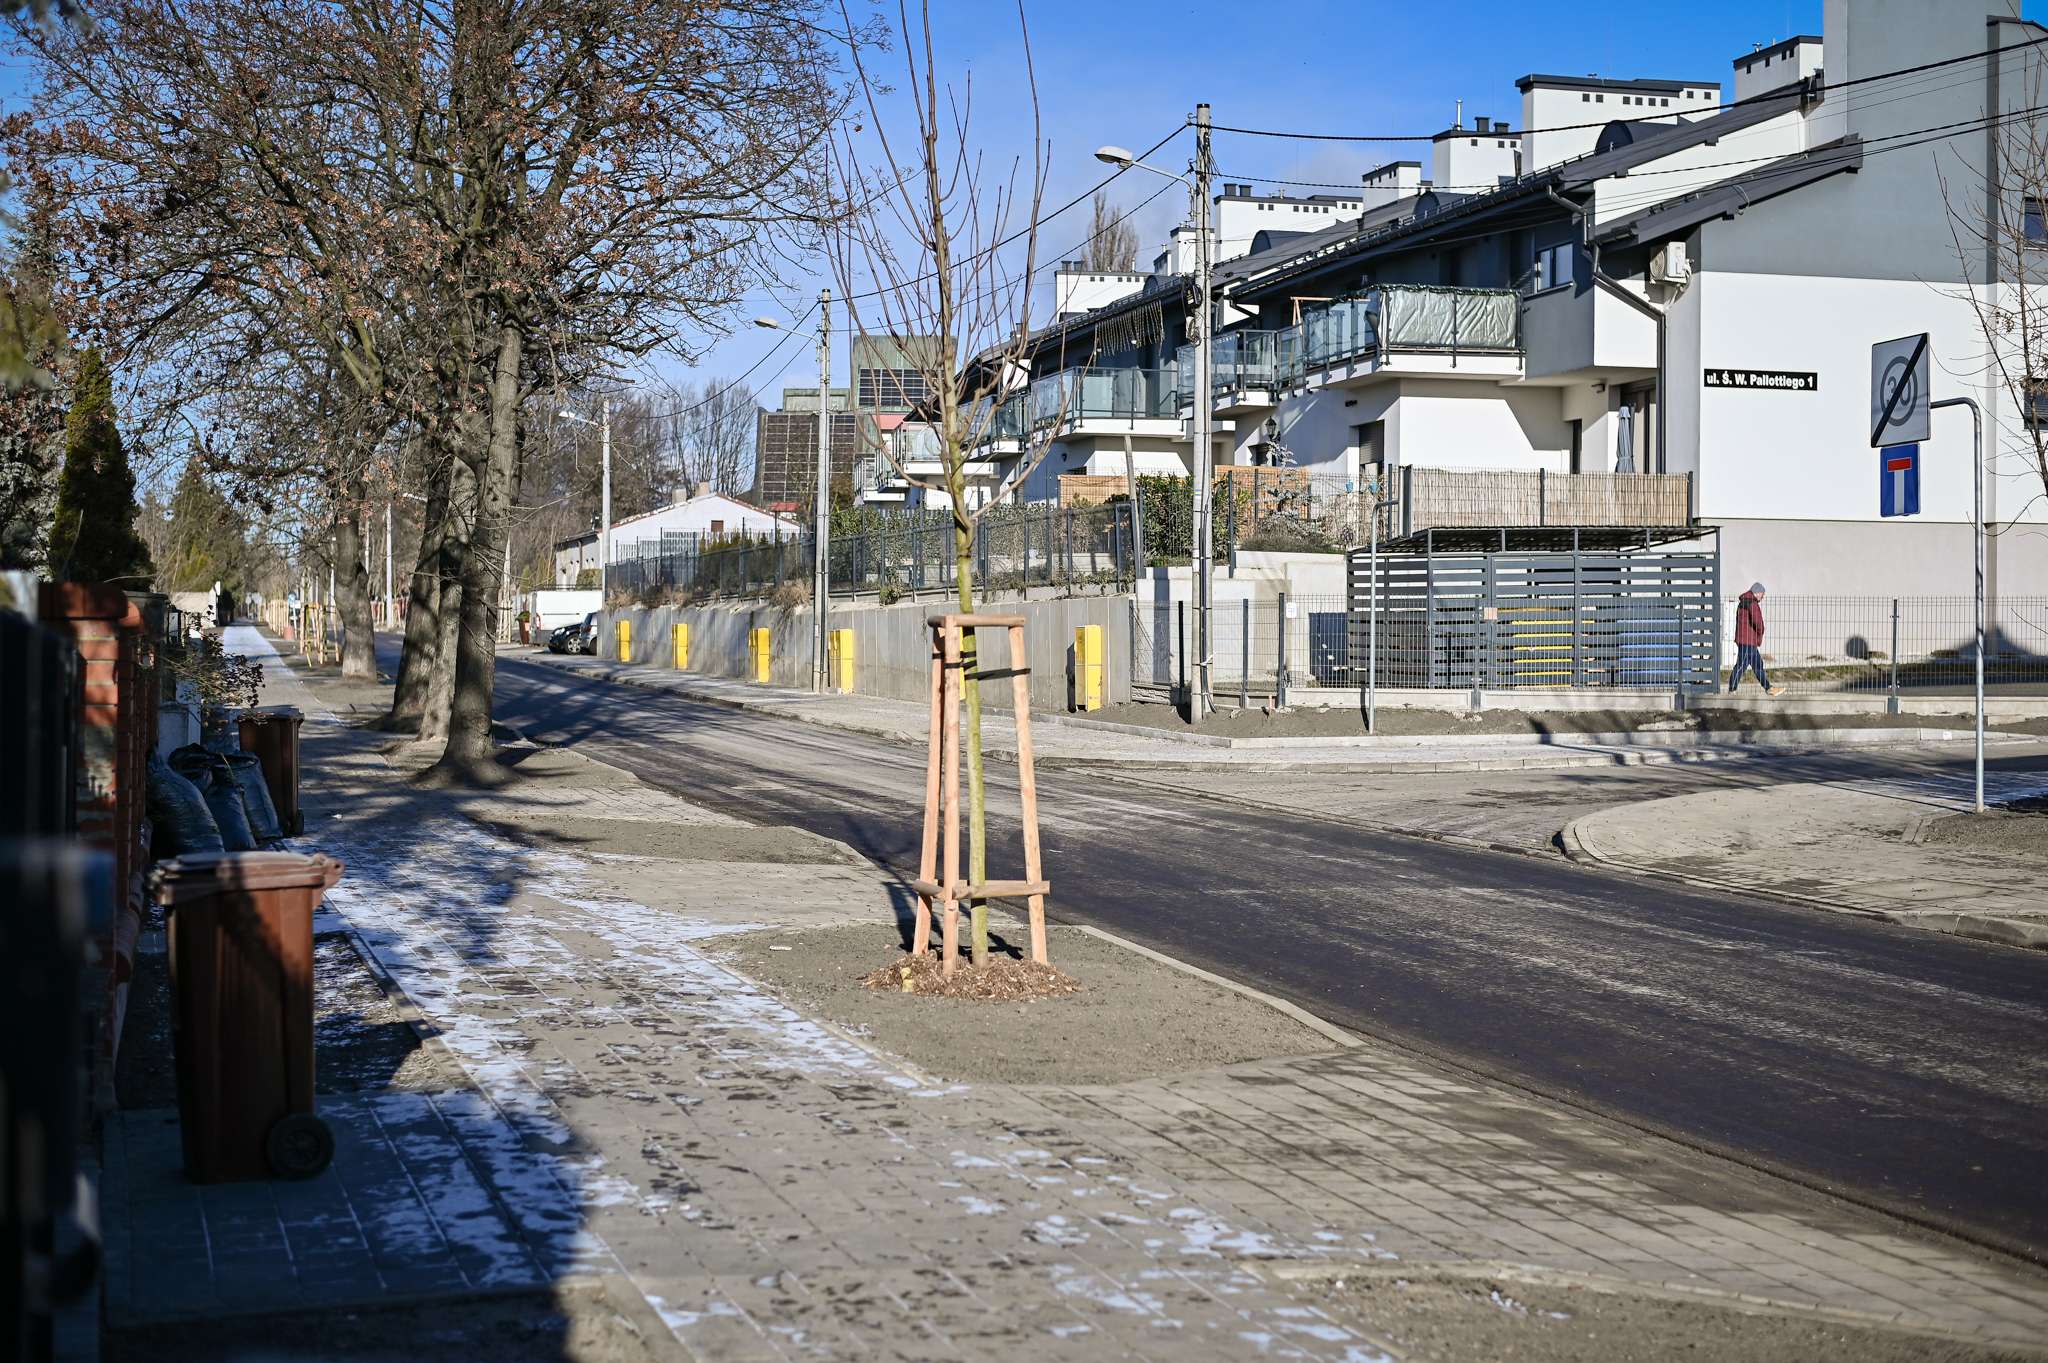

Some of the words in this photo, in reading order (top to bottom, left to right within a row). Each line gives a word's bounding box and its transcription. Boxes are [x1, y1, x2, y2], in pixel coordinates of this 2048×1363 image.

[1706, 373, 1720, 385] ul.
[1722, 371, 1733, 385] Ś.
[1735, 373, 1747, 386] W.
[1749, 373, 1805, 389] Pallottiego
[1807, 376, 1813, 388] 1
[1886, 375, 1911, 406] 30
